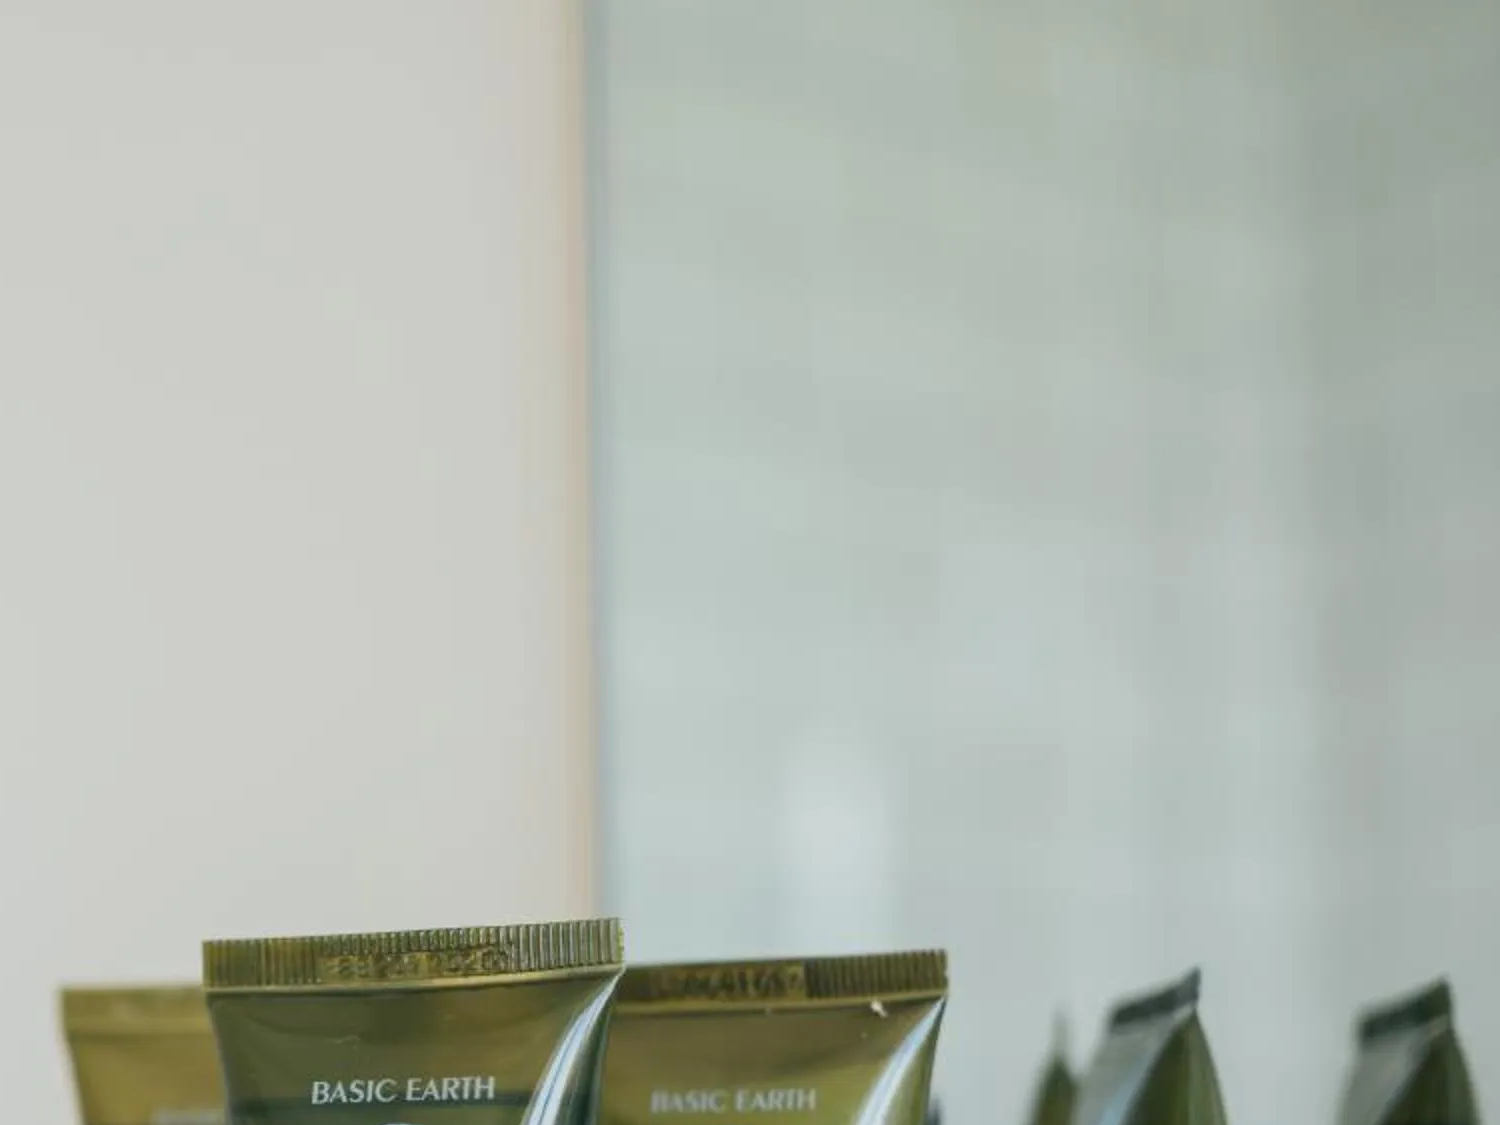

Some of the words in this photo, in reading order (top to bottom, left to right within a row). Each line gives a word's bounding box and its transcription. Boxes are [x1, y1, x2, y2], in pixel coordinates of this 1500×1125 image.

[311, 1079, 398, 1104] BASIC
[406, 1075, 496, 1101] EARTH
[650, 1089, 726, 1114] BASIC
[735, 1087, 817, 1112] EARTH
